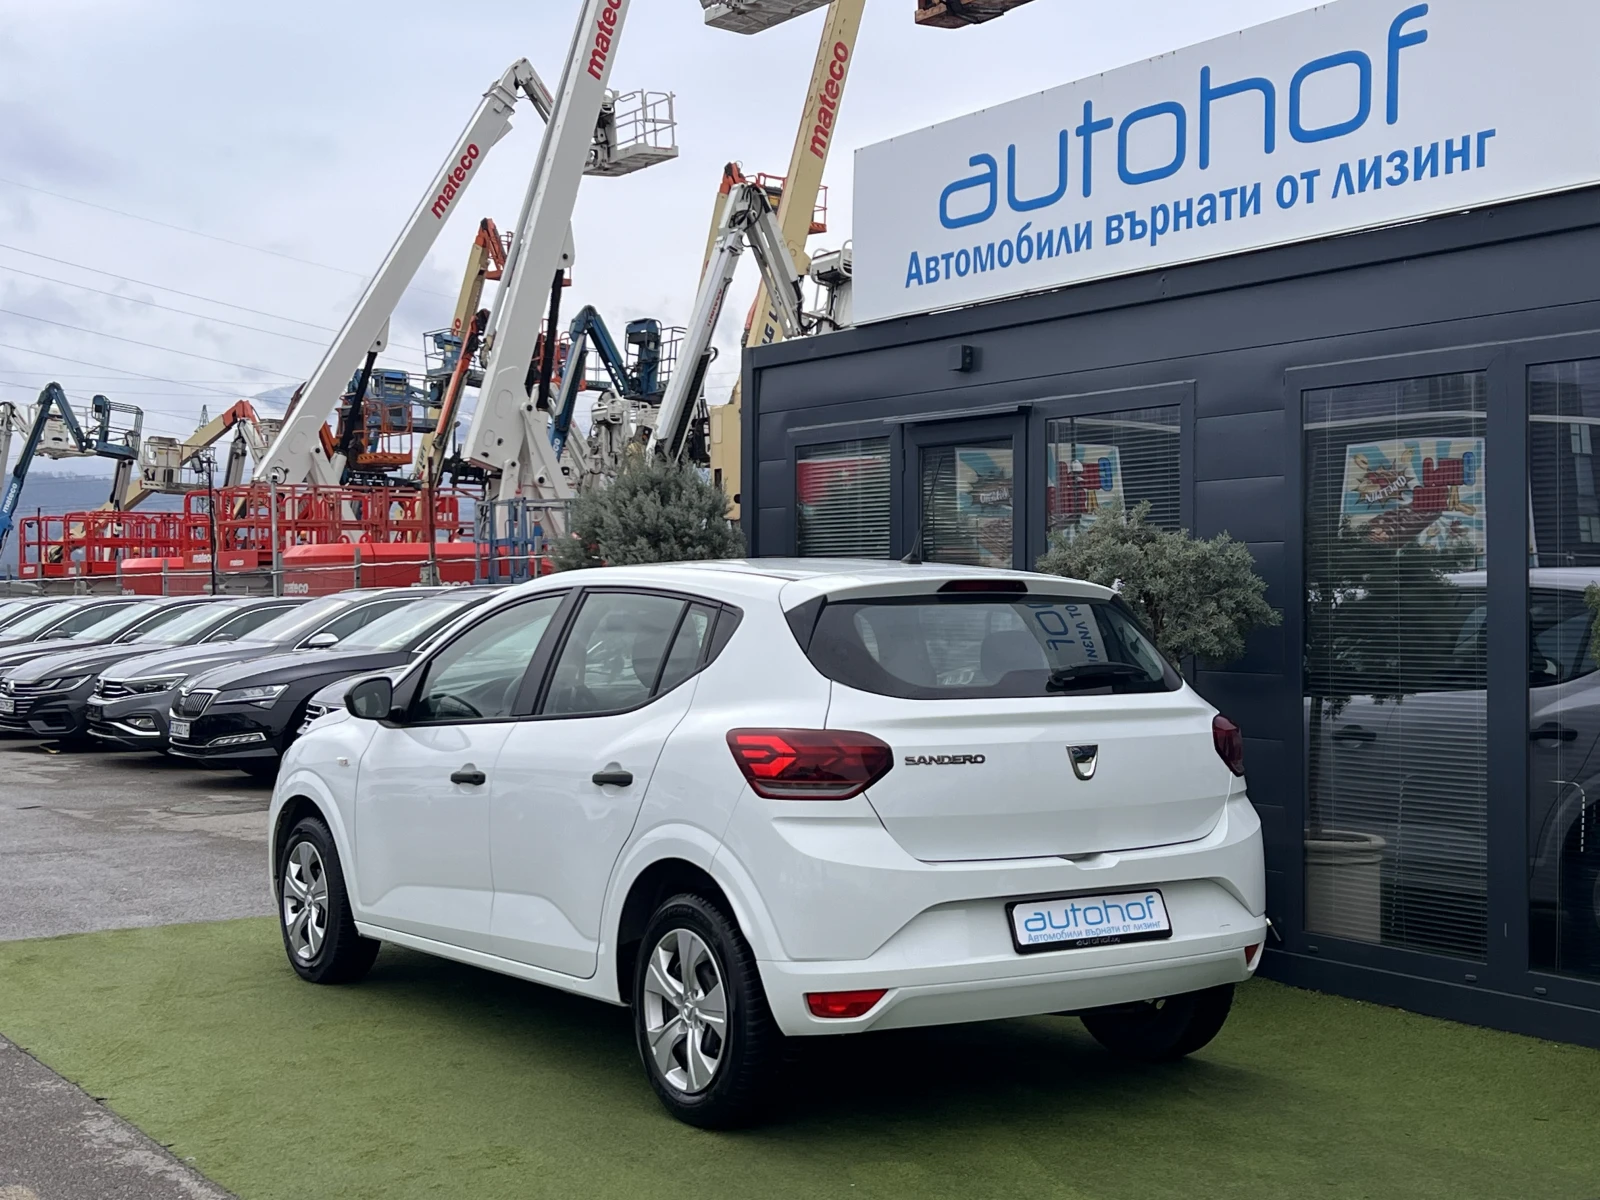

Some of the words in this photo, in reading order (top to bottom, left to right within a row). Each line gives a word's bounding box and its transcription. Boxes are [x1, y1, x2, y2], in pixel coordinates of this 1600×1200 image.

[810, 41, 849, 159] mateco
[939, 3, 1428, 230] autohof
[431, 143, 480, 219] mateco
[905, 221, 1093, 289] Автомобили
[1104, 183, 1262, 247] върнати
[1275, 168, 1321, 210] от
[1331, 128, 1497, 199] лизинг
[3, 483, 18, 514] mateco
[283, 580, 309, 594] mateco
[904, 754, 986, 766] SANDERO
[1024, 895, 1155, 932] autohof
[1027, 929, 1083, 943] Автомобили
[1085, 926, 1120, 937] върнати
[1133, 920, 1160, 930] лизинг
